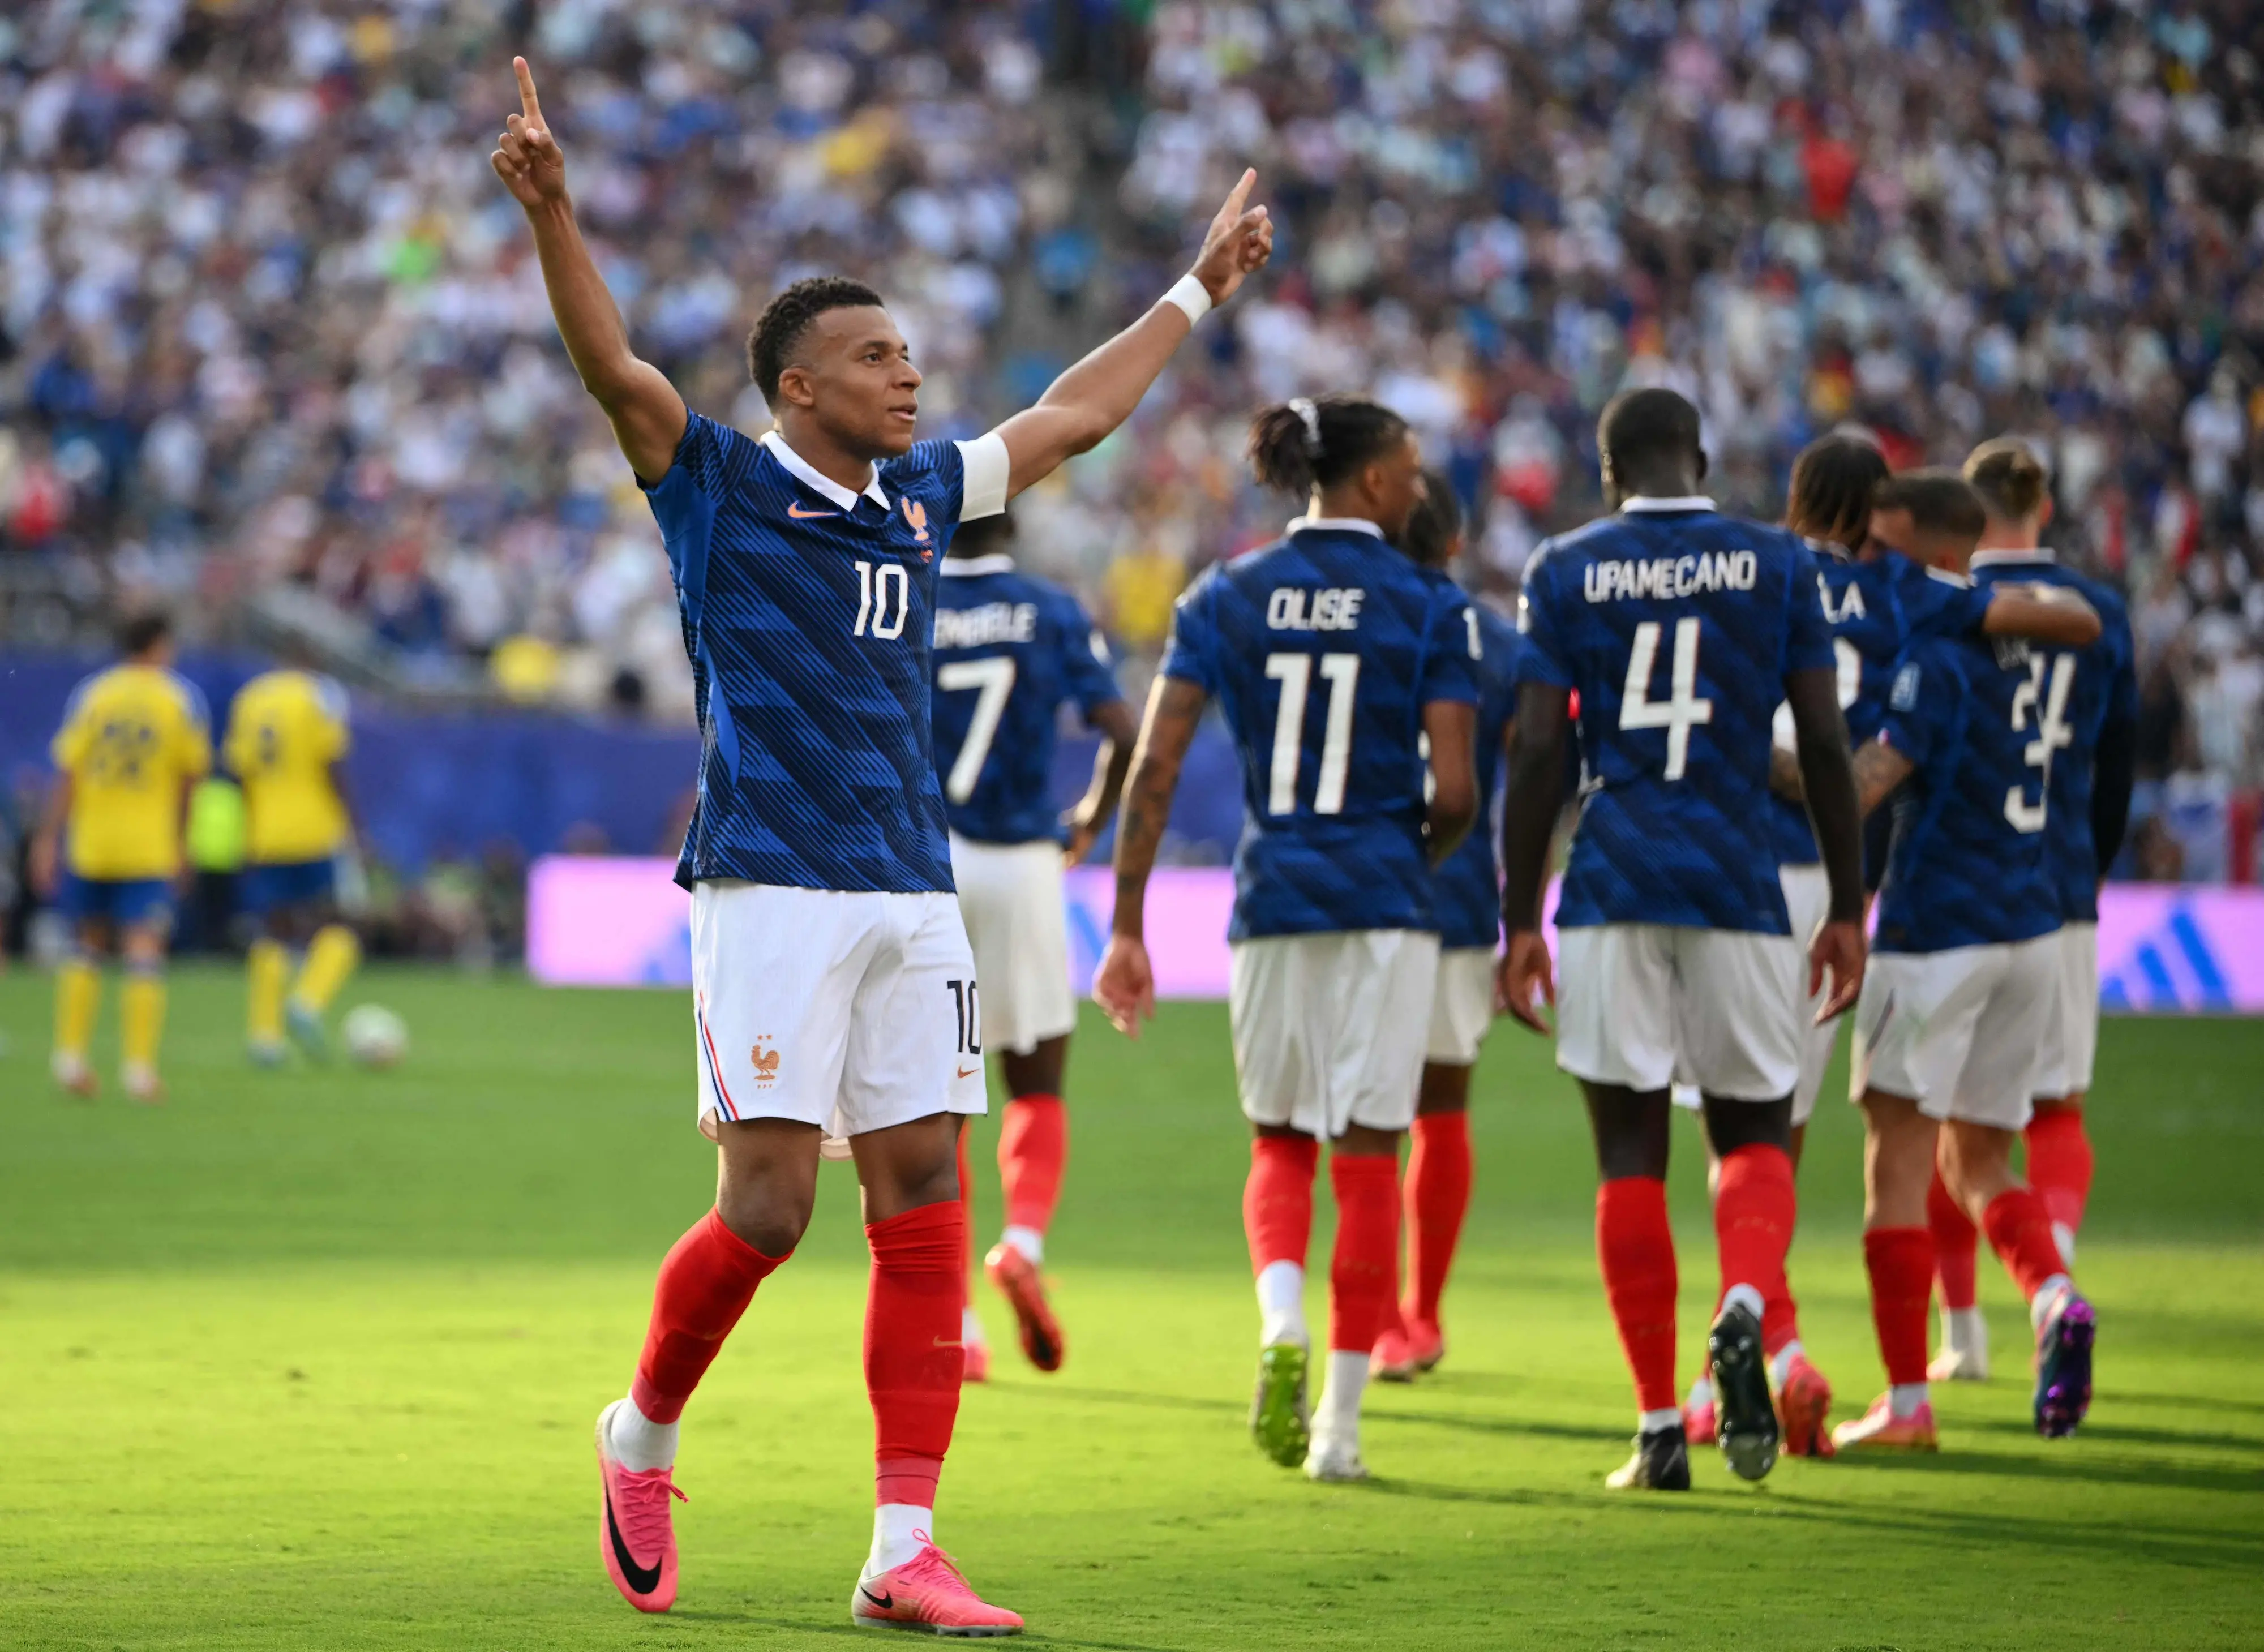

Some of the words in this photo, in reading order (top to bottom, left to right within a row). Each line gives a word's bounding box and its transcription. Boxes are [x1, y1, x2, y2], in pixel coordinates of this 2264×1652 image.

[853, 560, 908, 640] 10
[1266, 588, 1365, 630] OLISE
[1585, 550, 1757, 603] UPAMECANO
[937, 657, 1016, 806] 7
[1265, 652, 1360, 816] 11
[1619, 617, 1713, 782] 4
[947, 980, 981, 1054] 10
